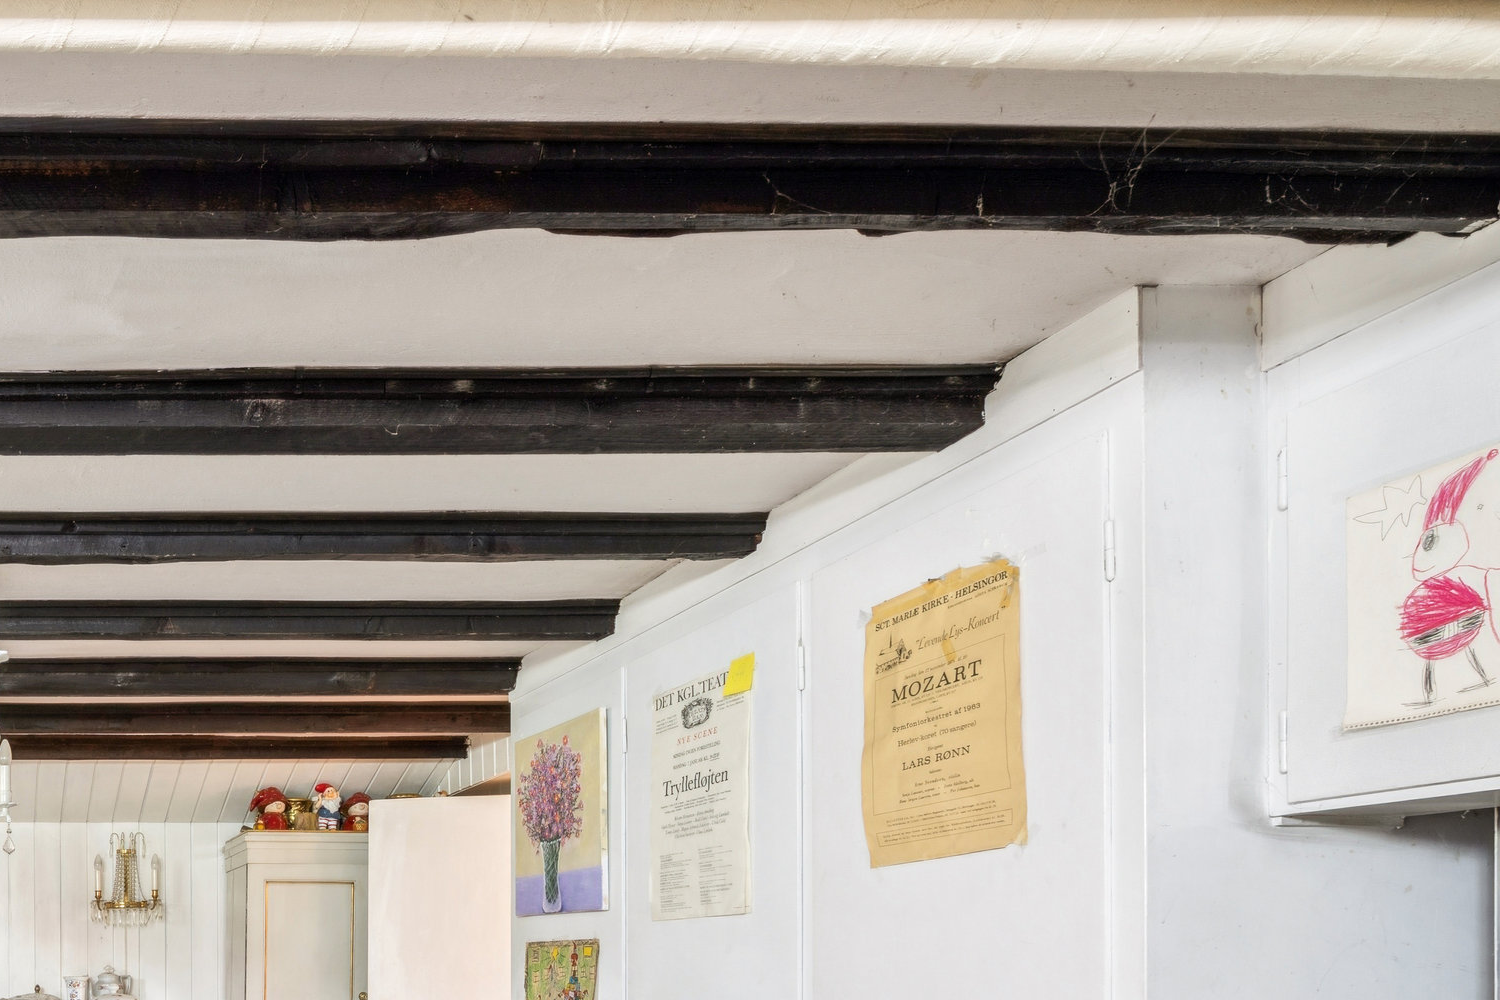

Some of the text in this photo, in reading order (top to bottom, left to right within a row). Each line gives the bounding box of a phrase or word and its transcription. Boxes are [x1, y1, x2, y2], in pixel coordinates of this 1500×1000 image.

[875, 620, 890, 632] SCT.
[892, 607, 919, 626] MARIÆ
[922, 595, 949, 613] KIRKE
[954, 571, 1008, 598] HELSINGØR
[655, 693, 675, 711] DET
[698, 671, 729, 693] TEAT
[891, 659, 982, 703] MOZART
[676, 726, 718, 746] NYE SCENE
[892, 710, 952, 733] Symfoniorkestret
[954, 707, 962, 716] af
[902, 745, 971, 771] LARS RØNN
[663, 769, 729, 801] Tryllefløjten
